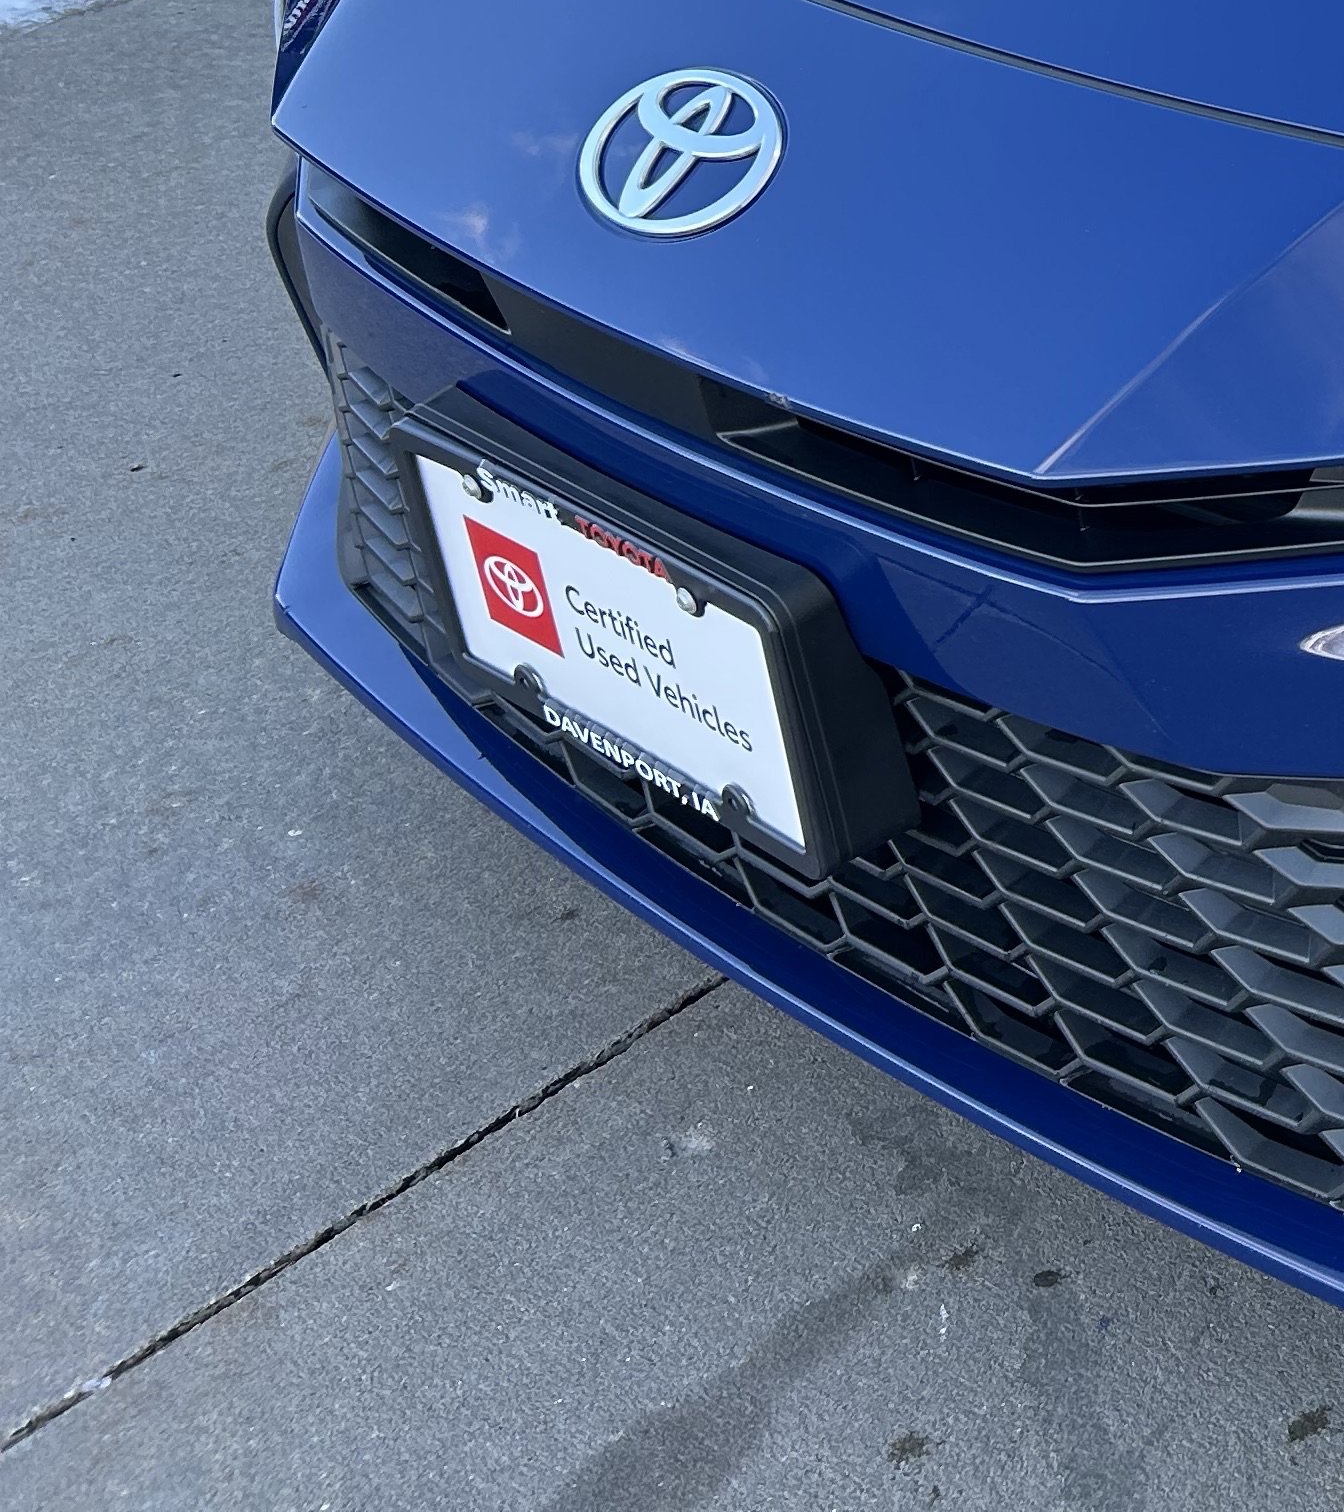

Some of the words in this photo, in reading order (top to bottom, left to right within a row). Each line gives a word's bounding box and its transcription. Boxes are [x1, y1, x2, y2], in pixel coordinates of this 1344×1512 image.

[477, 465, 559, 519] Smart
[574, 514, 673, 584] TOYOTA
[566, 585, 677, 668] Certified
[574, 627, 641, 685] Used
[642, 666, 753, 752] Vehicles
[543, 704, 688, 805] DAVENPORT,
[691, 790, 720, 822] IA
